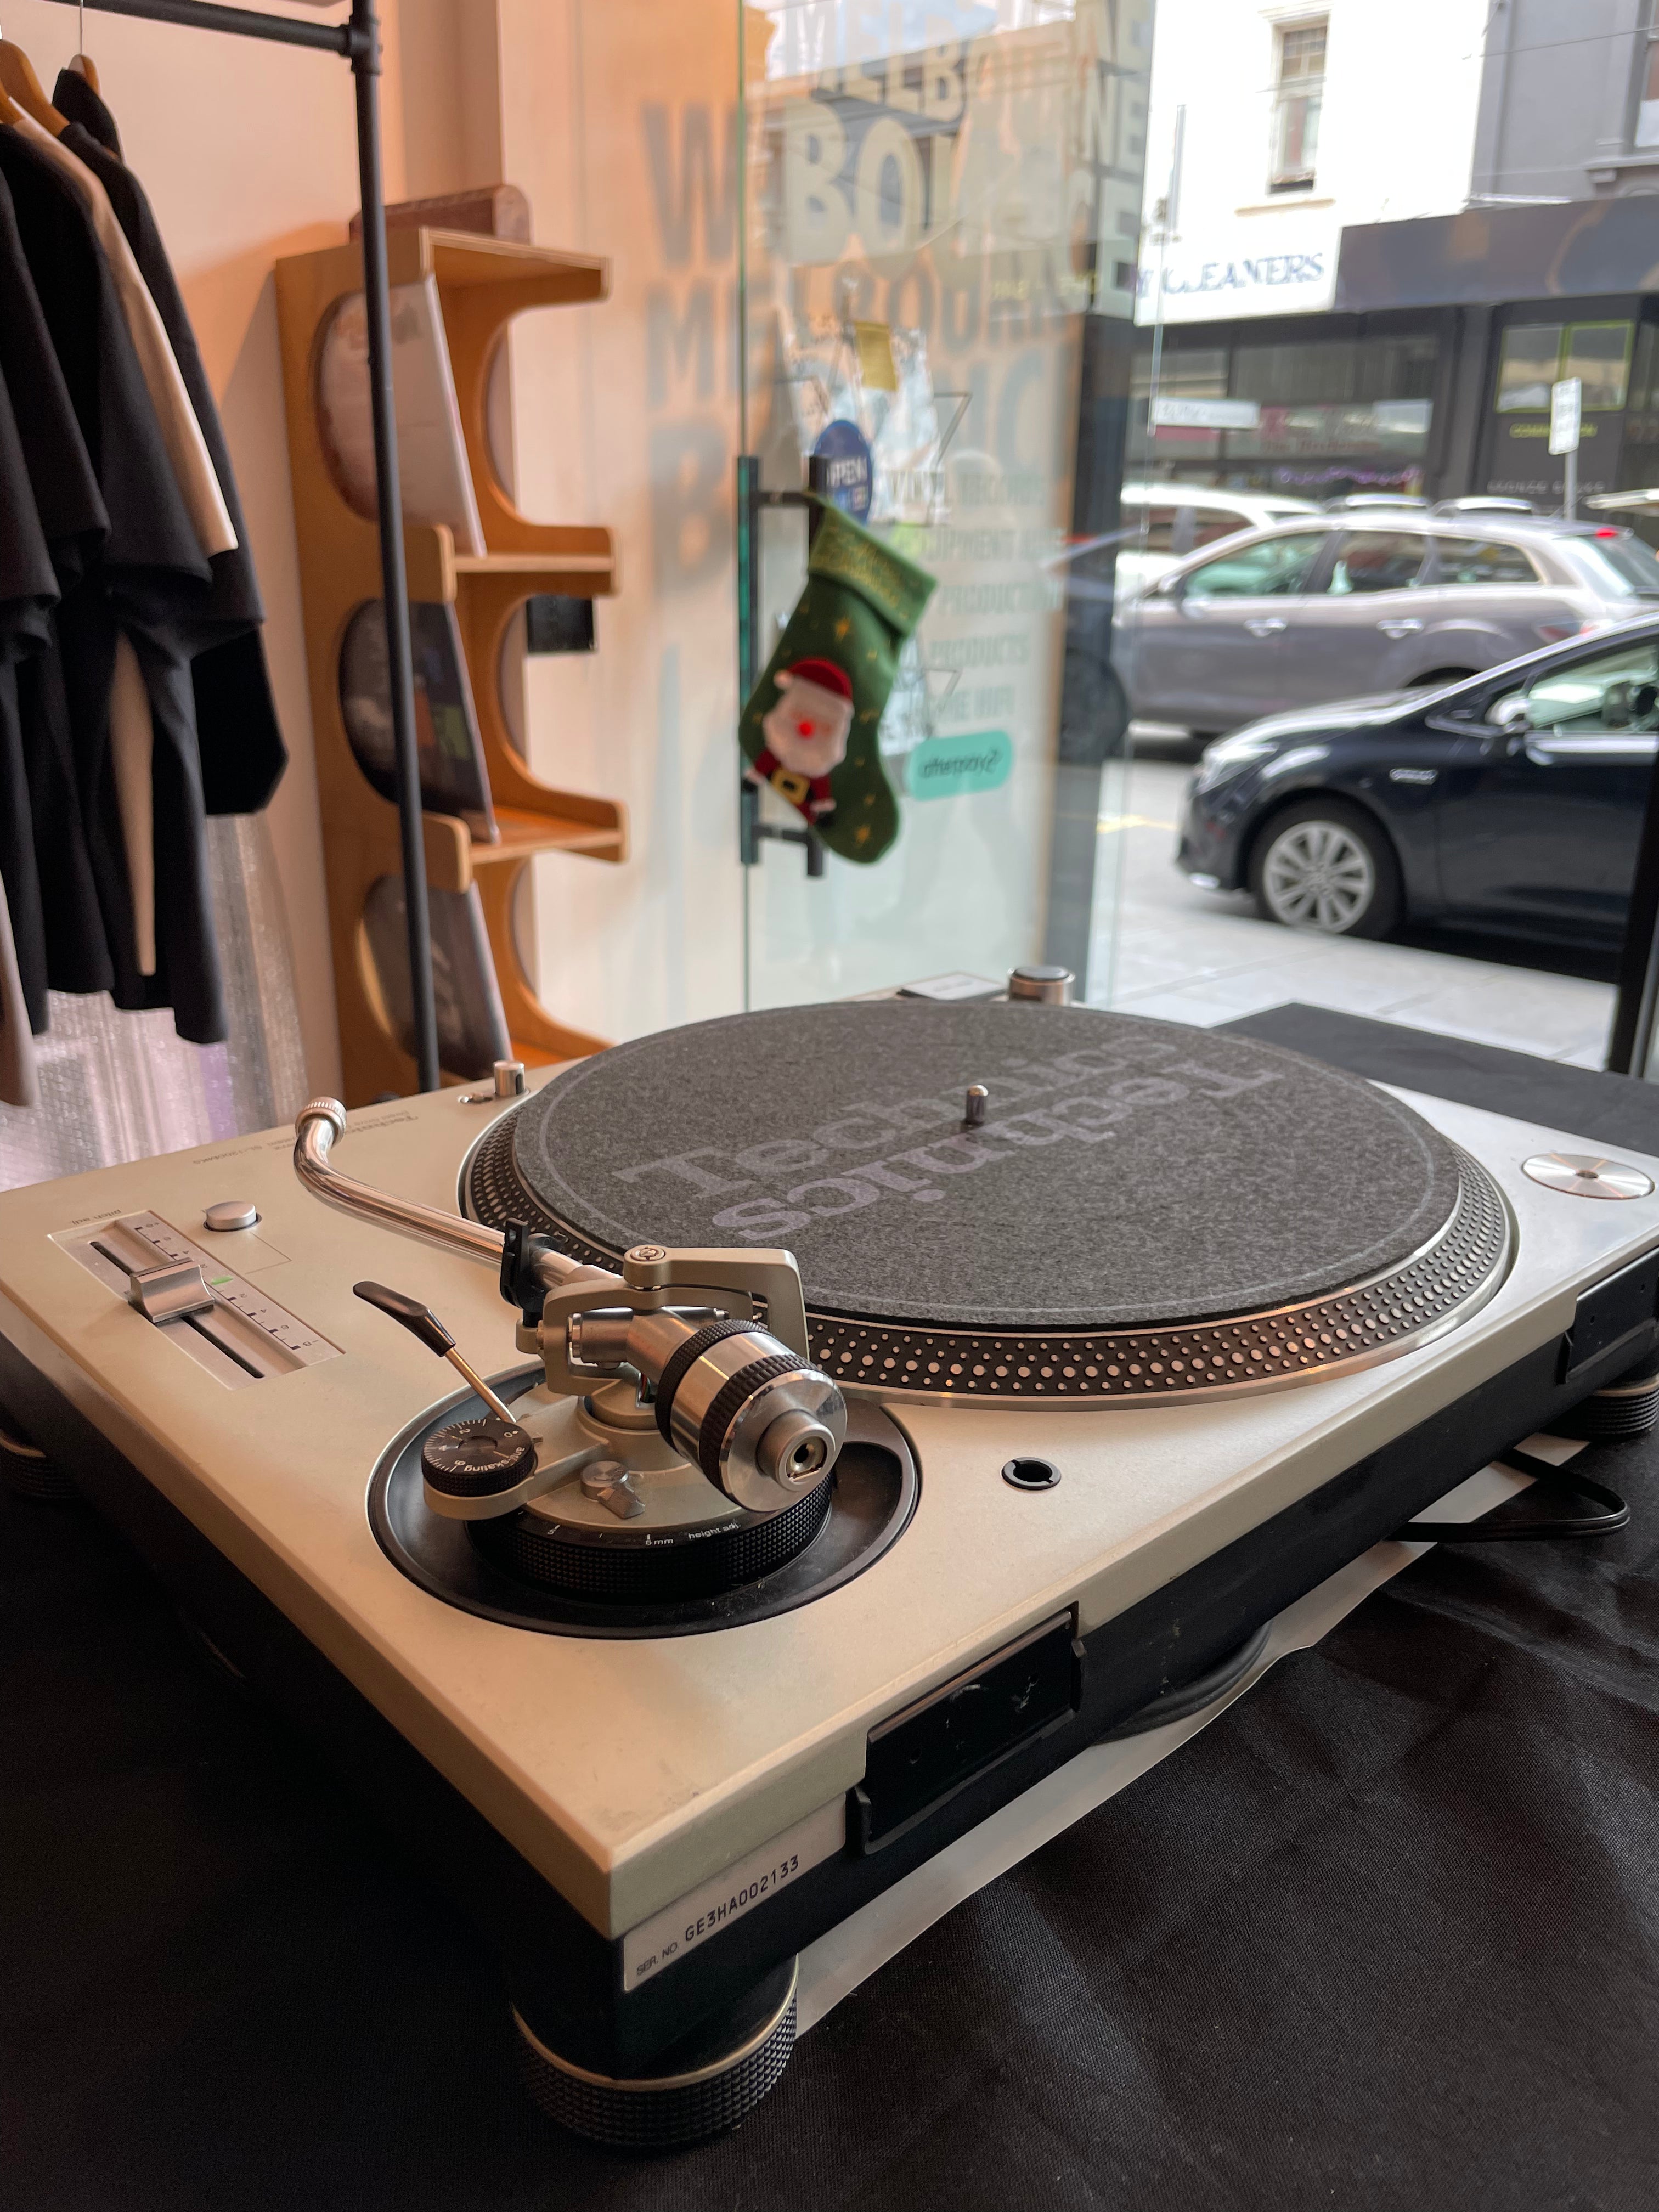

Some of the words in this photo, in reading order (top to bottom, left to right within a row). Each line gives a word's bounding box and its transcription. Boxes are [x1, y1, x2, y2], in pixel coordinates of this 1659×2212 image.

[826, 456, 868, 488] PEN
[712, 1060, 1284, 1240] Technics
[688, 1527, 721, 1540] height
[685, 1854, 799, 1942] GE3HA002133
